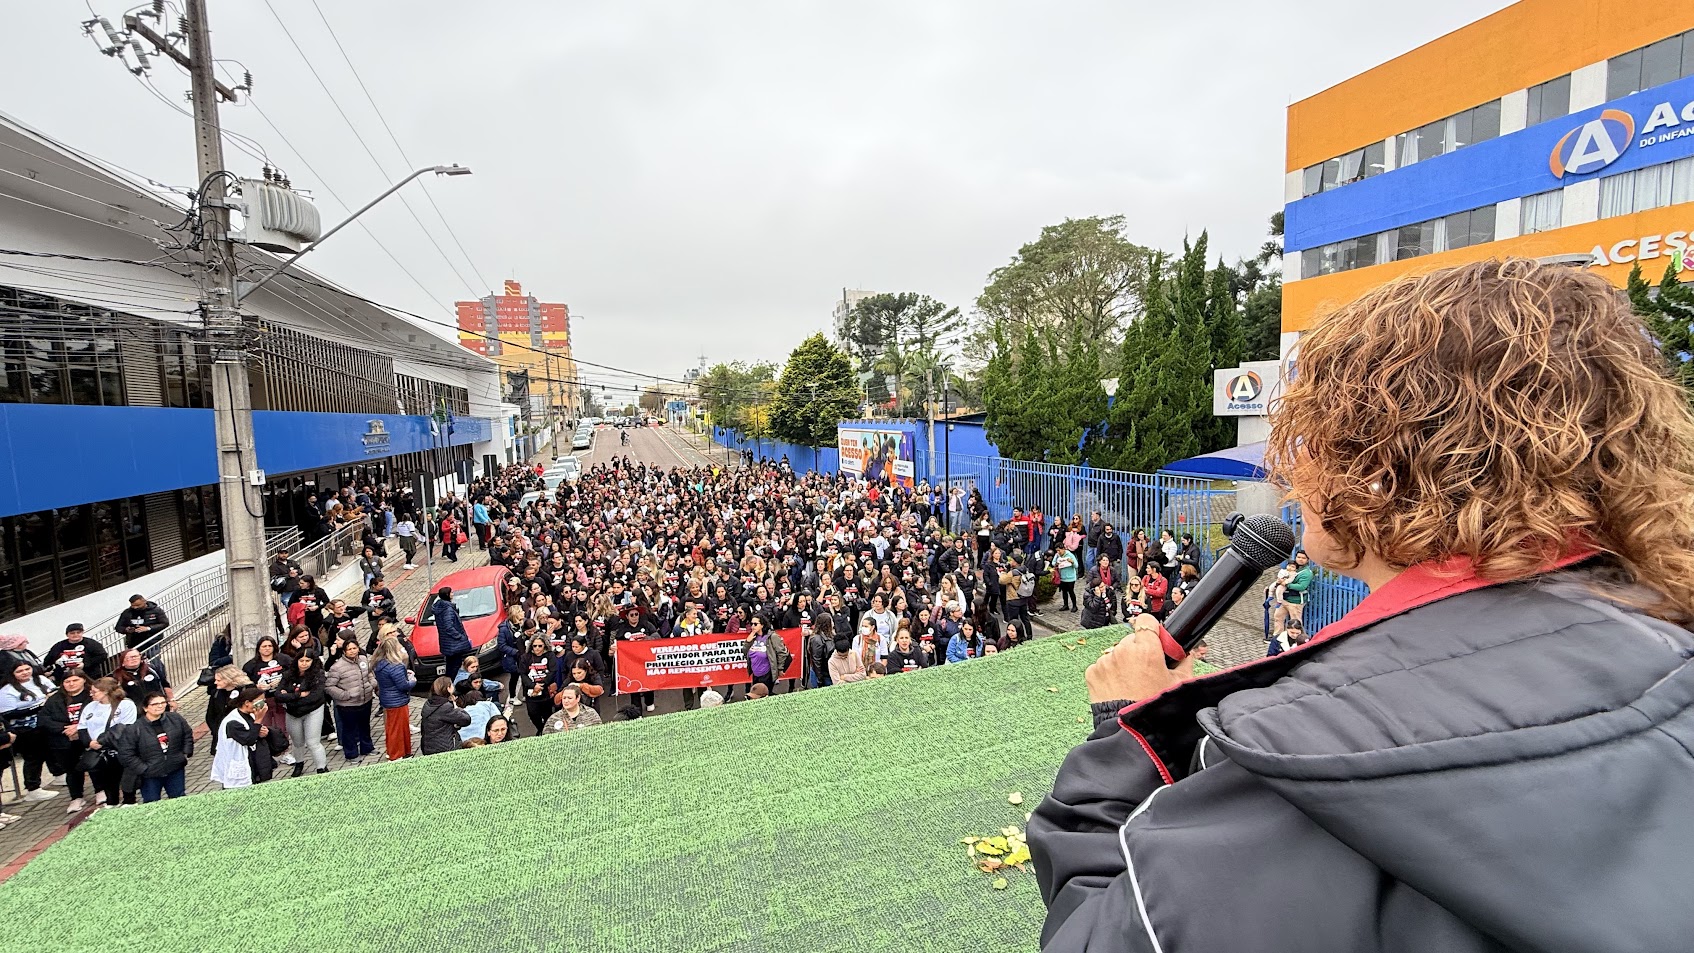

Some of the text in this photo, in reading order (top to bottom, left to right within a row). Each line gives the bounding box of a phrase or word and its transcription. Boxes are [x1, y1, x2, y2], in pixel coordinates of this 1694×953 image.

[1639, 136, 1656, 148] DO
[842, 446, 862, 460] ACESSO
[650, 644, 699, 654] VEREADOR
[656, 651, 700, 661] SERVIDOR
[702, 649, 726, 657] PARA
[646, 658, 695, 668] PRIVILÉGIO
[646, 667, 666, 676] NÃO
[668, 664, 723, 674] REPRESENTA
[732, 662, 748, 670] POV
